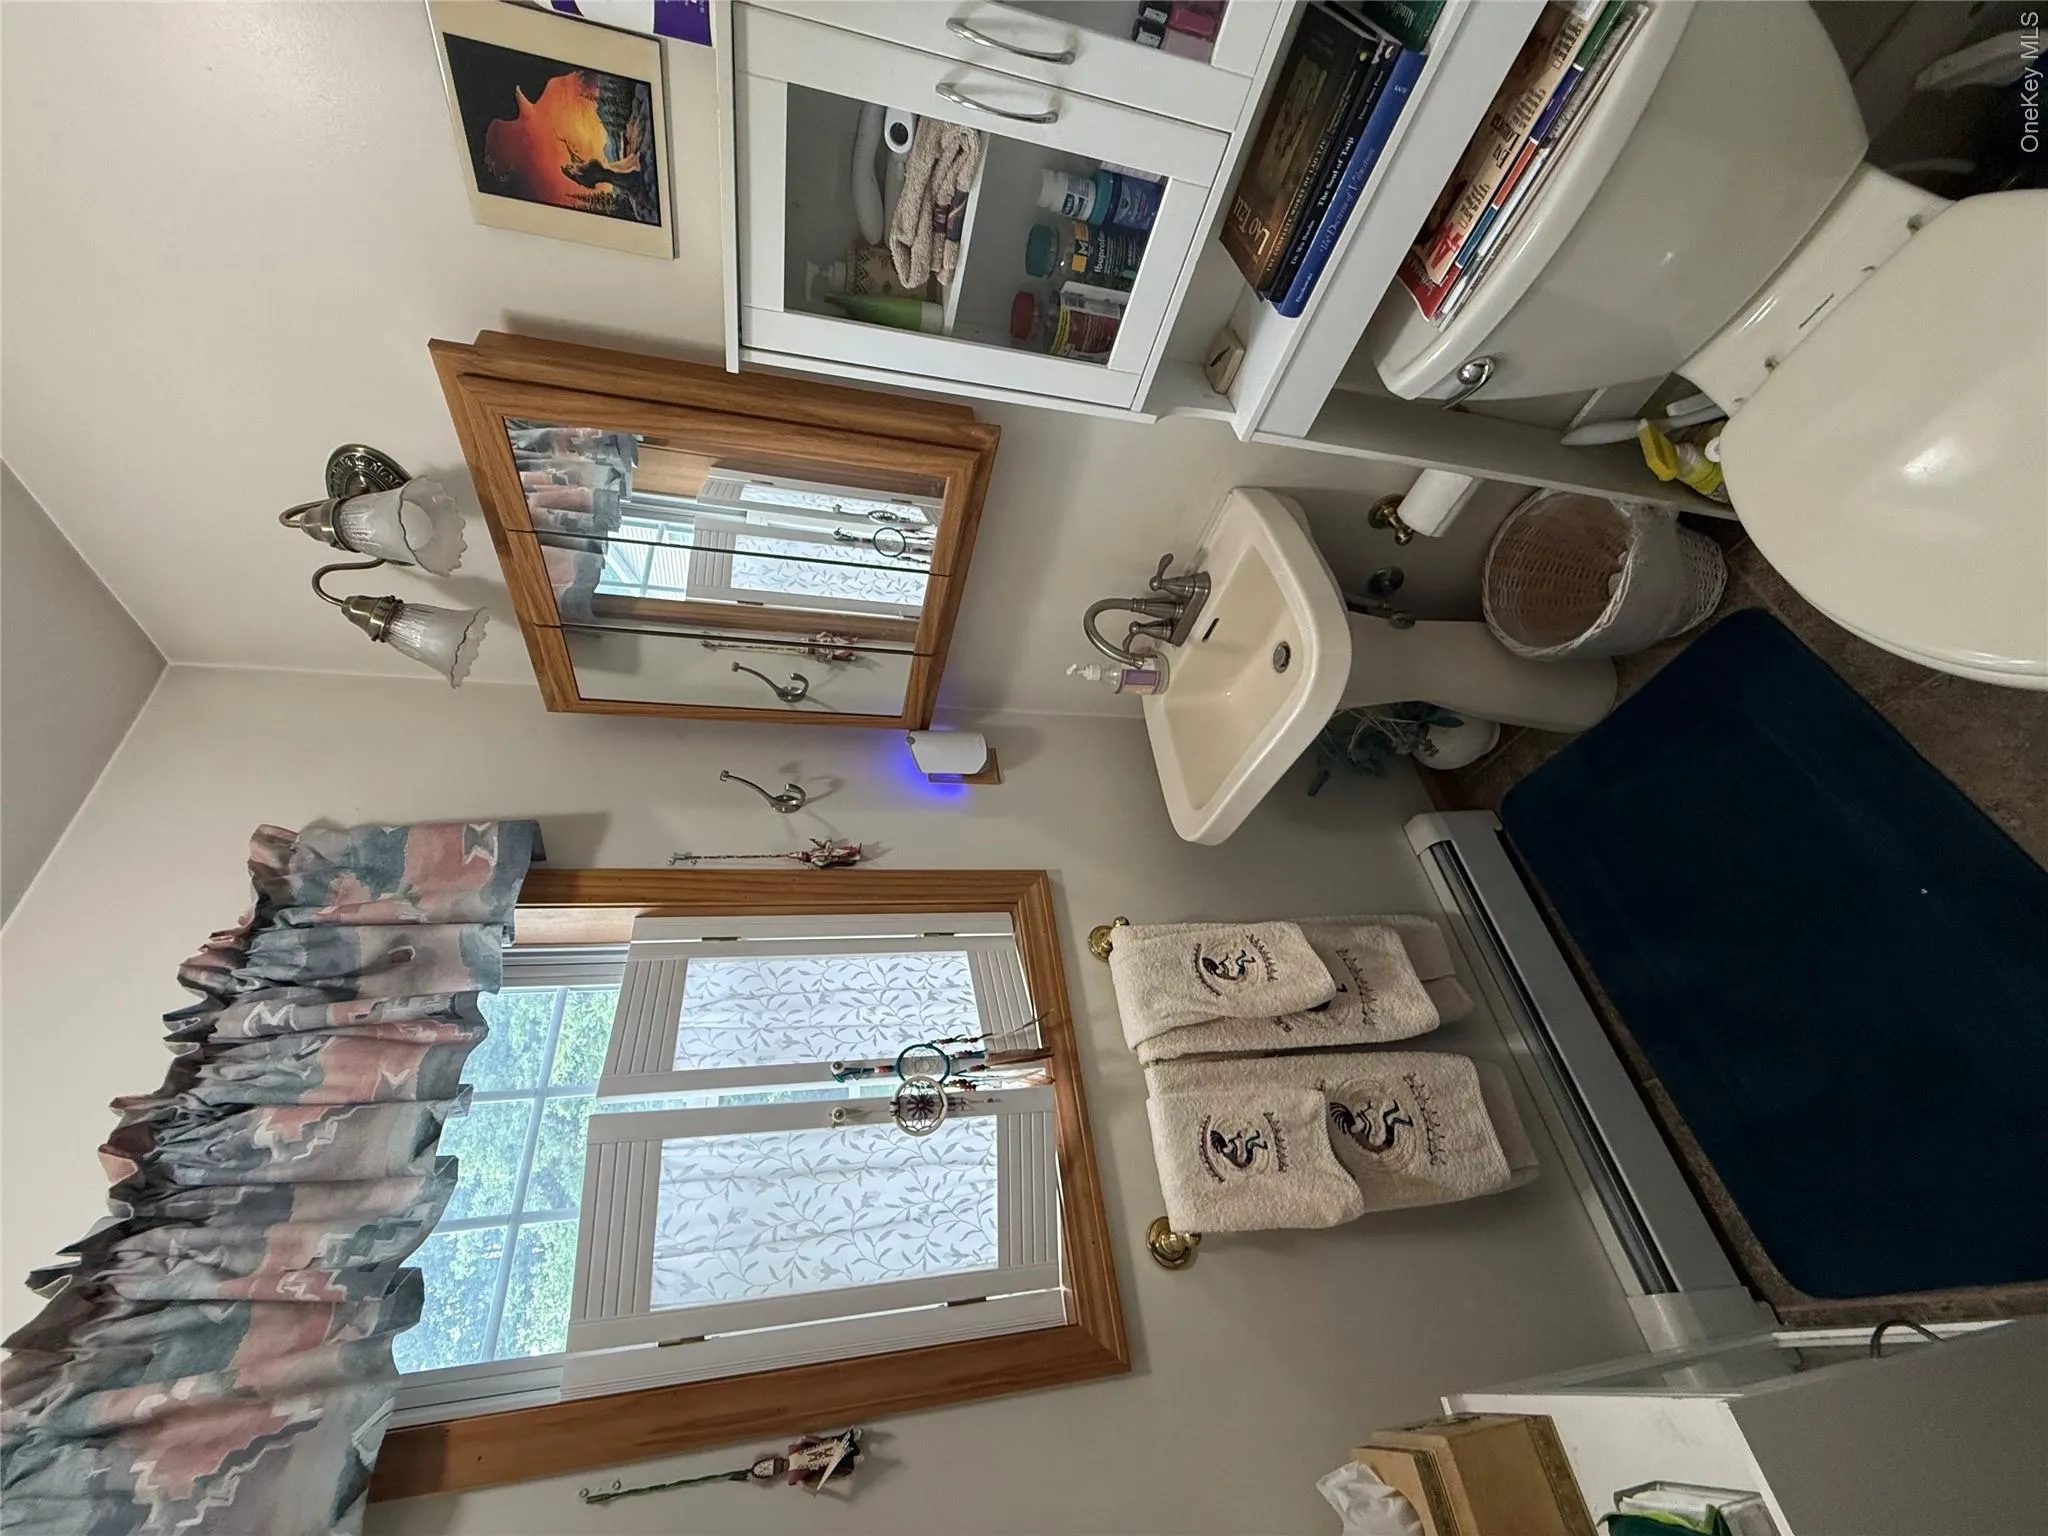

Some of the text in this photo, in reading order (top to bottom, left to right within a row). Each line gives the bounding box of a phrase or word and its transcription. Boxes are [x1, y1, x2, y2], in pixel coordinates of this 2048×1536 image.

[1317, 193, 1328, 207] The
[1327, 171, 1339, 190] Soul
[1337, 159, 1344, 170] of
